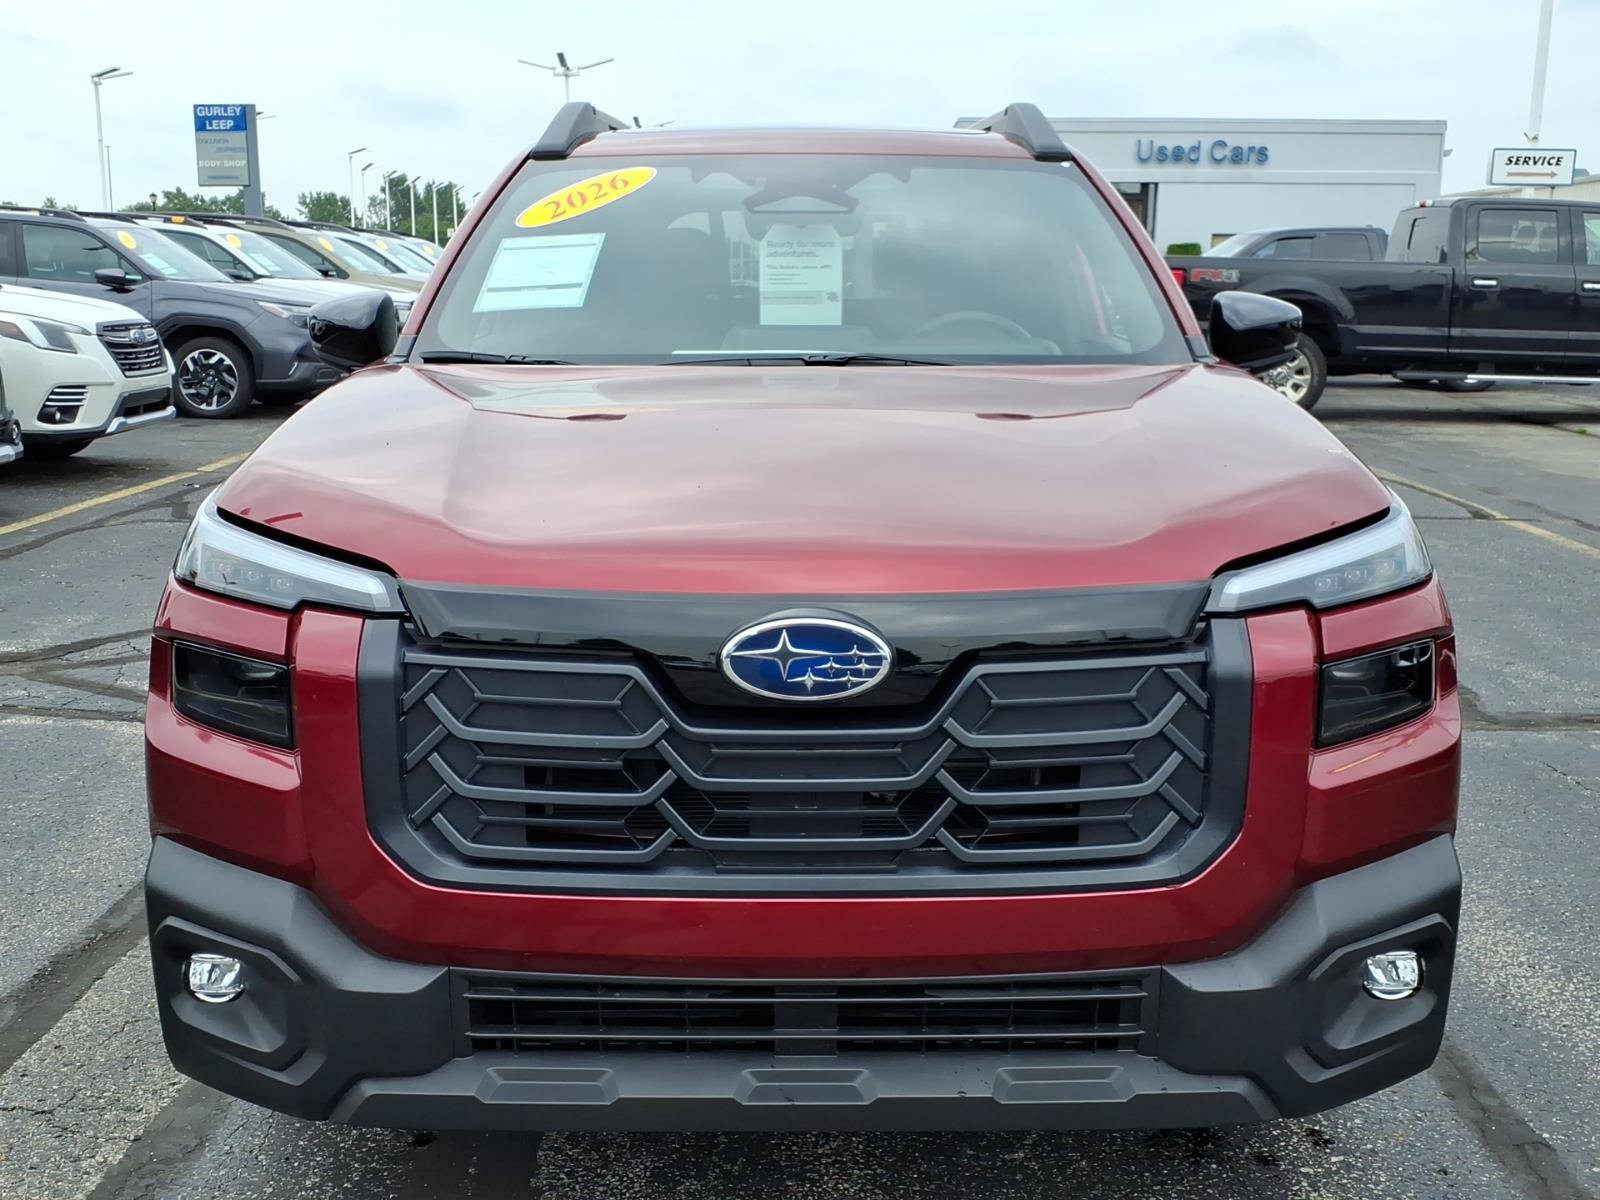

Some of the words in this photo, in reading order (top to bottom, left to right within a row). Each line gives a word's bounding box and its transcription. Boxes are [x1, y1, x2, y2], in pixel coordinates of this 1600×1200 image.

[197, 106, 241, 116] GURLEY
[206, 120, 234, 129] LEEP
[1136, 139, 1202, 163] Used
[1210, 139, 1270, 164] Cars
[1505, 155, 1564, 166] SERVICE
[544, 174, 630, 220] 2026
[767, 241, 794, 249] Ready
